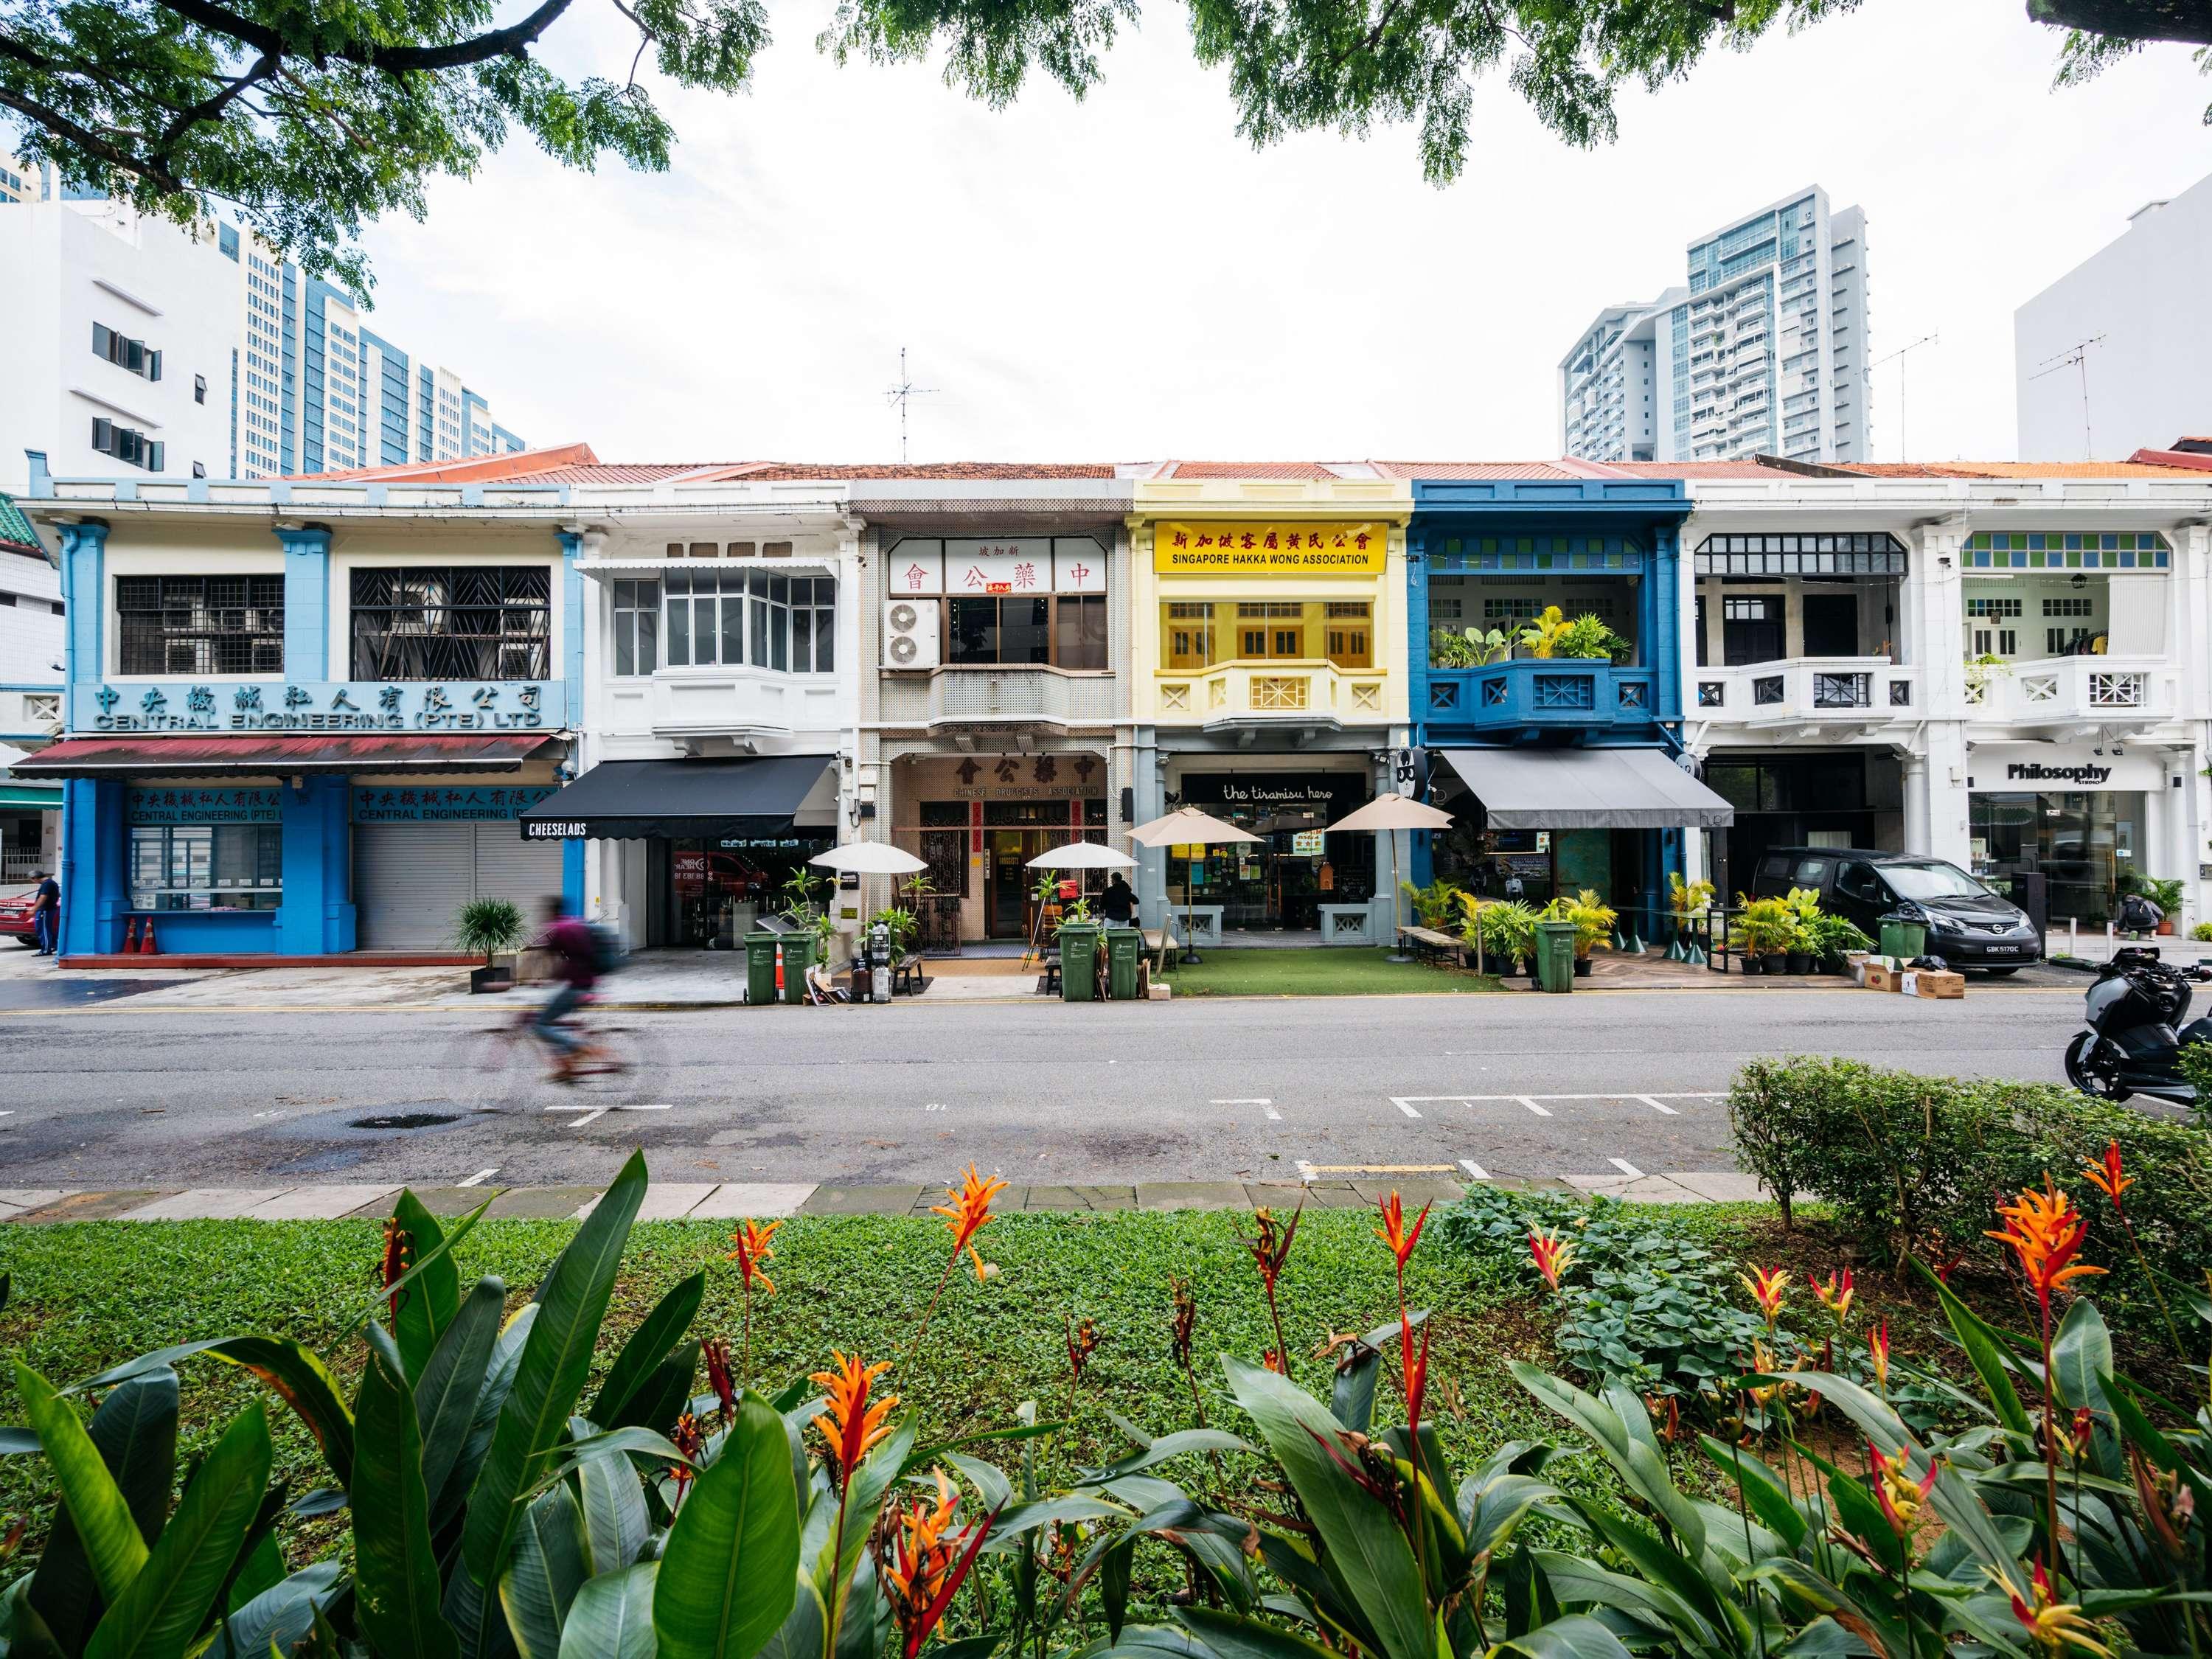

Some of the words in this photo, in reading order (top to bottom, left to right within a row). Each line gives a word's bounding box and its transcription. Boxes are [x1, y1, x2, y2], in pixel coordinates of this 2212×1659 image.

[979, 545, 1019, 557] 新加坡
[1172, 554, 1229, 564] SINGAPORE
[1233, 554, 1266, 564] HAKKA
[1270, 554, 1299, 564] WONG
[1302, 554, 1368, 564] ASSOCIATION
[903, 563, 1090, 590] 中藥公會
[94, 684, 541, 714] 中央機械私人有限公司
[93, 712, 220, 729] CENTRAL
[229, 712, 404, 728] ENGINEERING
[414, 710, 484, 728] (PTE)
[494, 712, 542, 726] LTD
[2008, 763, 2112, 782] Philosophy
[954, 787, 986, 797] CHINESE
[996, 787, 1038, 796] DRUGGISTS
[1048, 786, 1098, 796] ASSOCIATION
[1223, 785, 1248, 799] the
[1251, 785, 1304, 799] tiramisu
[1308, 785, 1333, 799] hero
[131, 811, 177, 821] CENTRAL
[182, 810, 247, 821] ENGINEERING
[251, 810, 276, 821] (PTE)
[359, 810, 415, 820] CENTRAL
[422, 809, 507, 819] ENGINEERING
[529, 822, 587, 836] CHEESELADS
